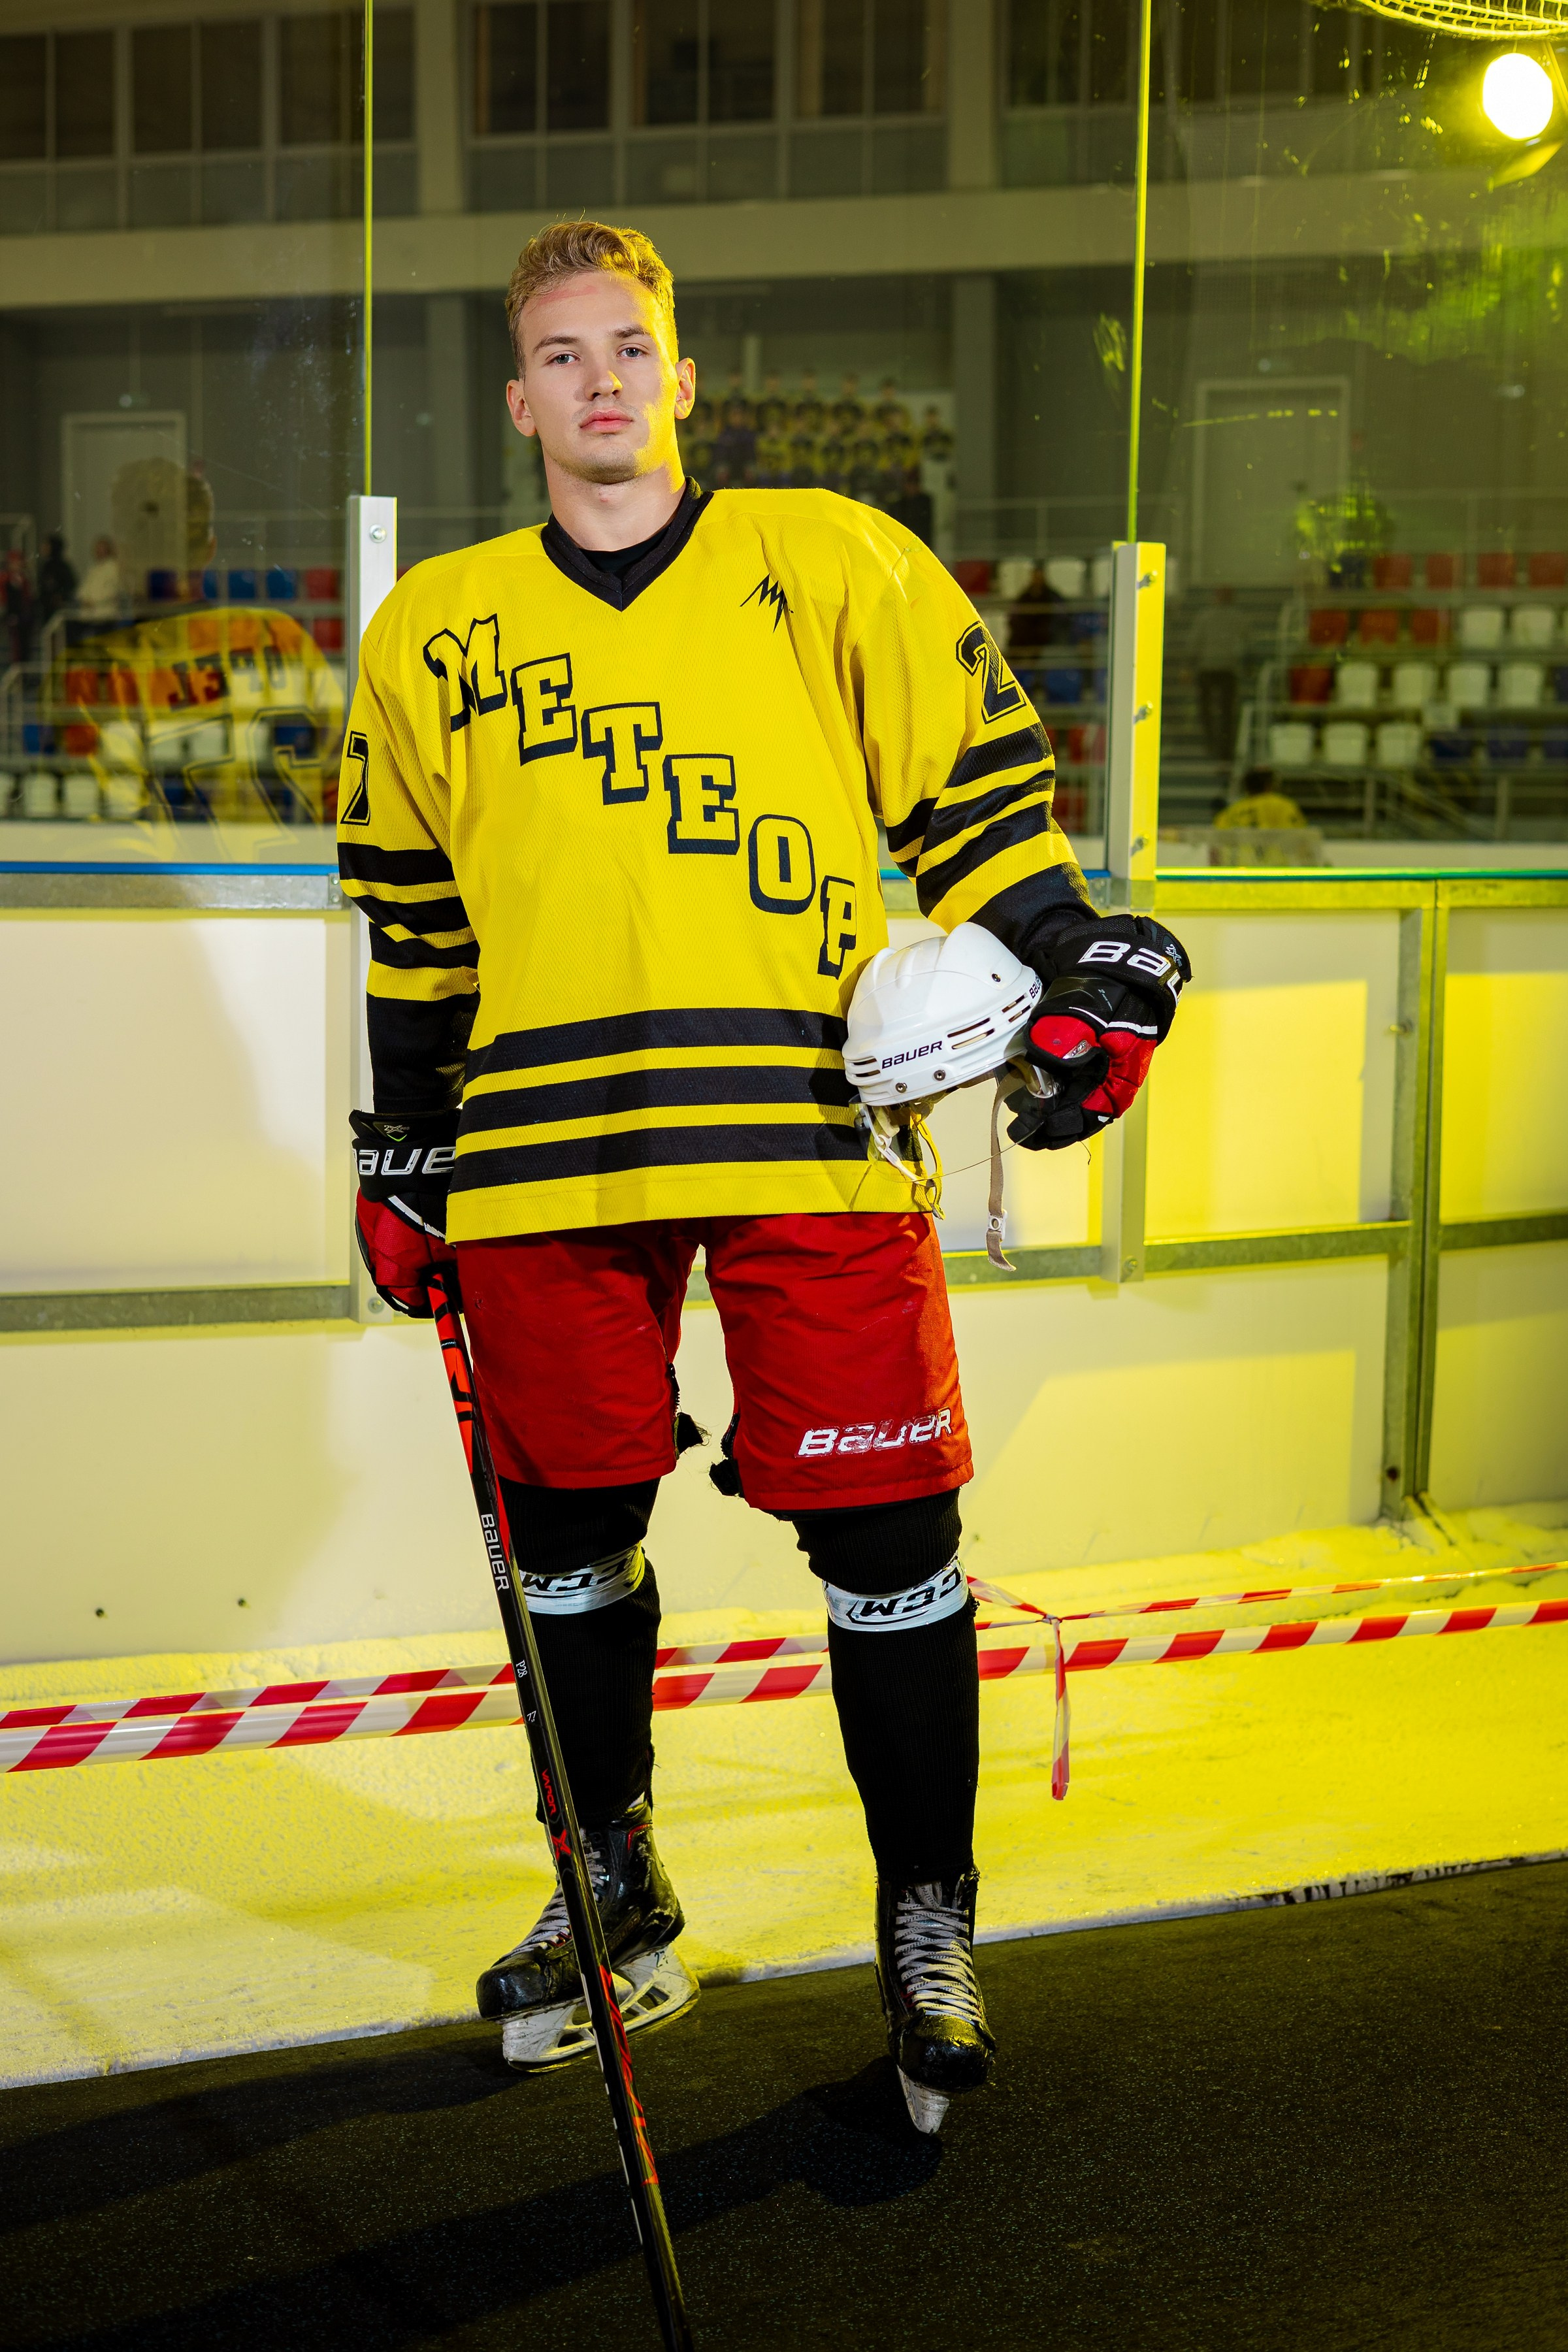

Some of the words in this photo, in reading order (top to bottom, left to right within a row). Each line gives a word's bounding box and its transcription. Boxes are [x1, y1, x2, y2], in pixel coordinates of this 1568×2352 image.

[956, 621, 1027, 725] 2
[881, 1040, 943, 1070] BAUER
[794, 1406, 952, 1458] BAUER
[481, 1513, 509, 1591] BAUER
[515, 1659, 528, 1678] P28
[527, 1710, 537, 1722] 77
[541, 1769, 556, 1816] VAPOR
